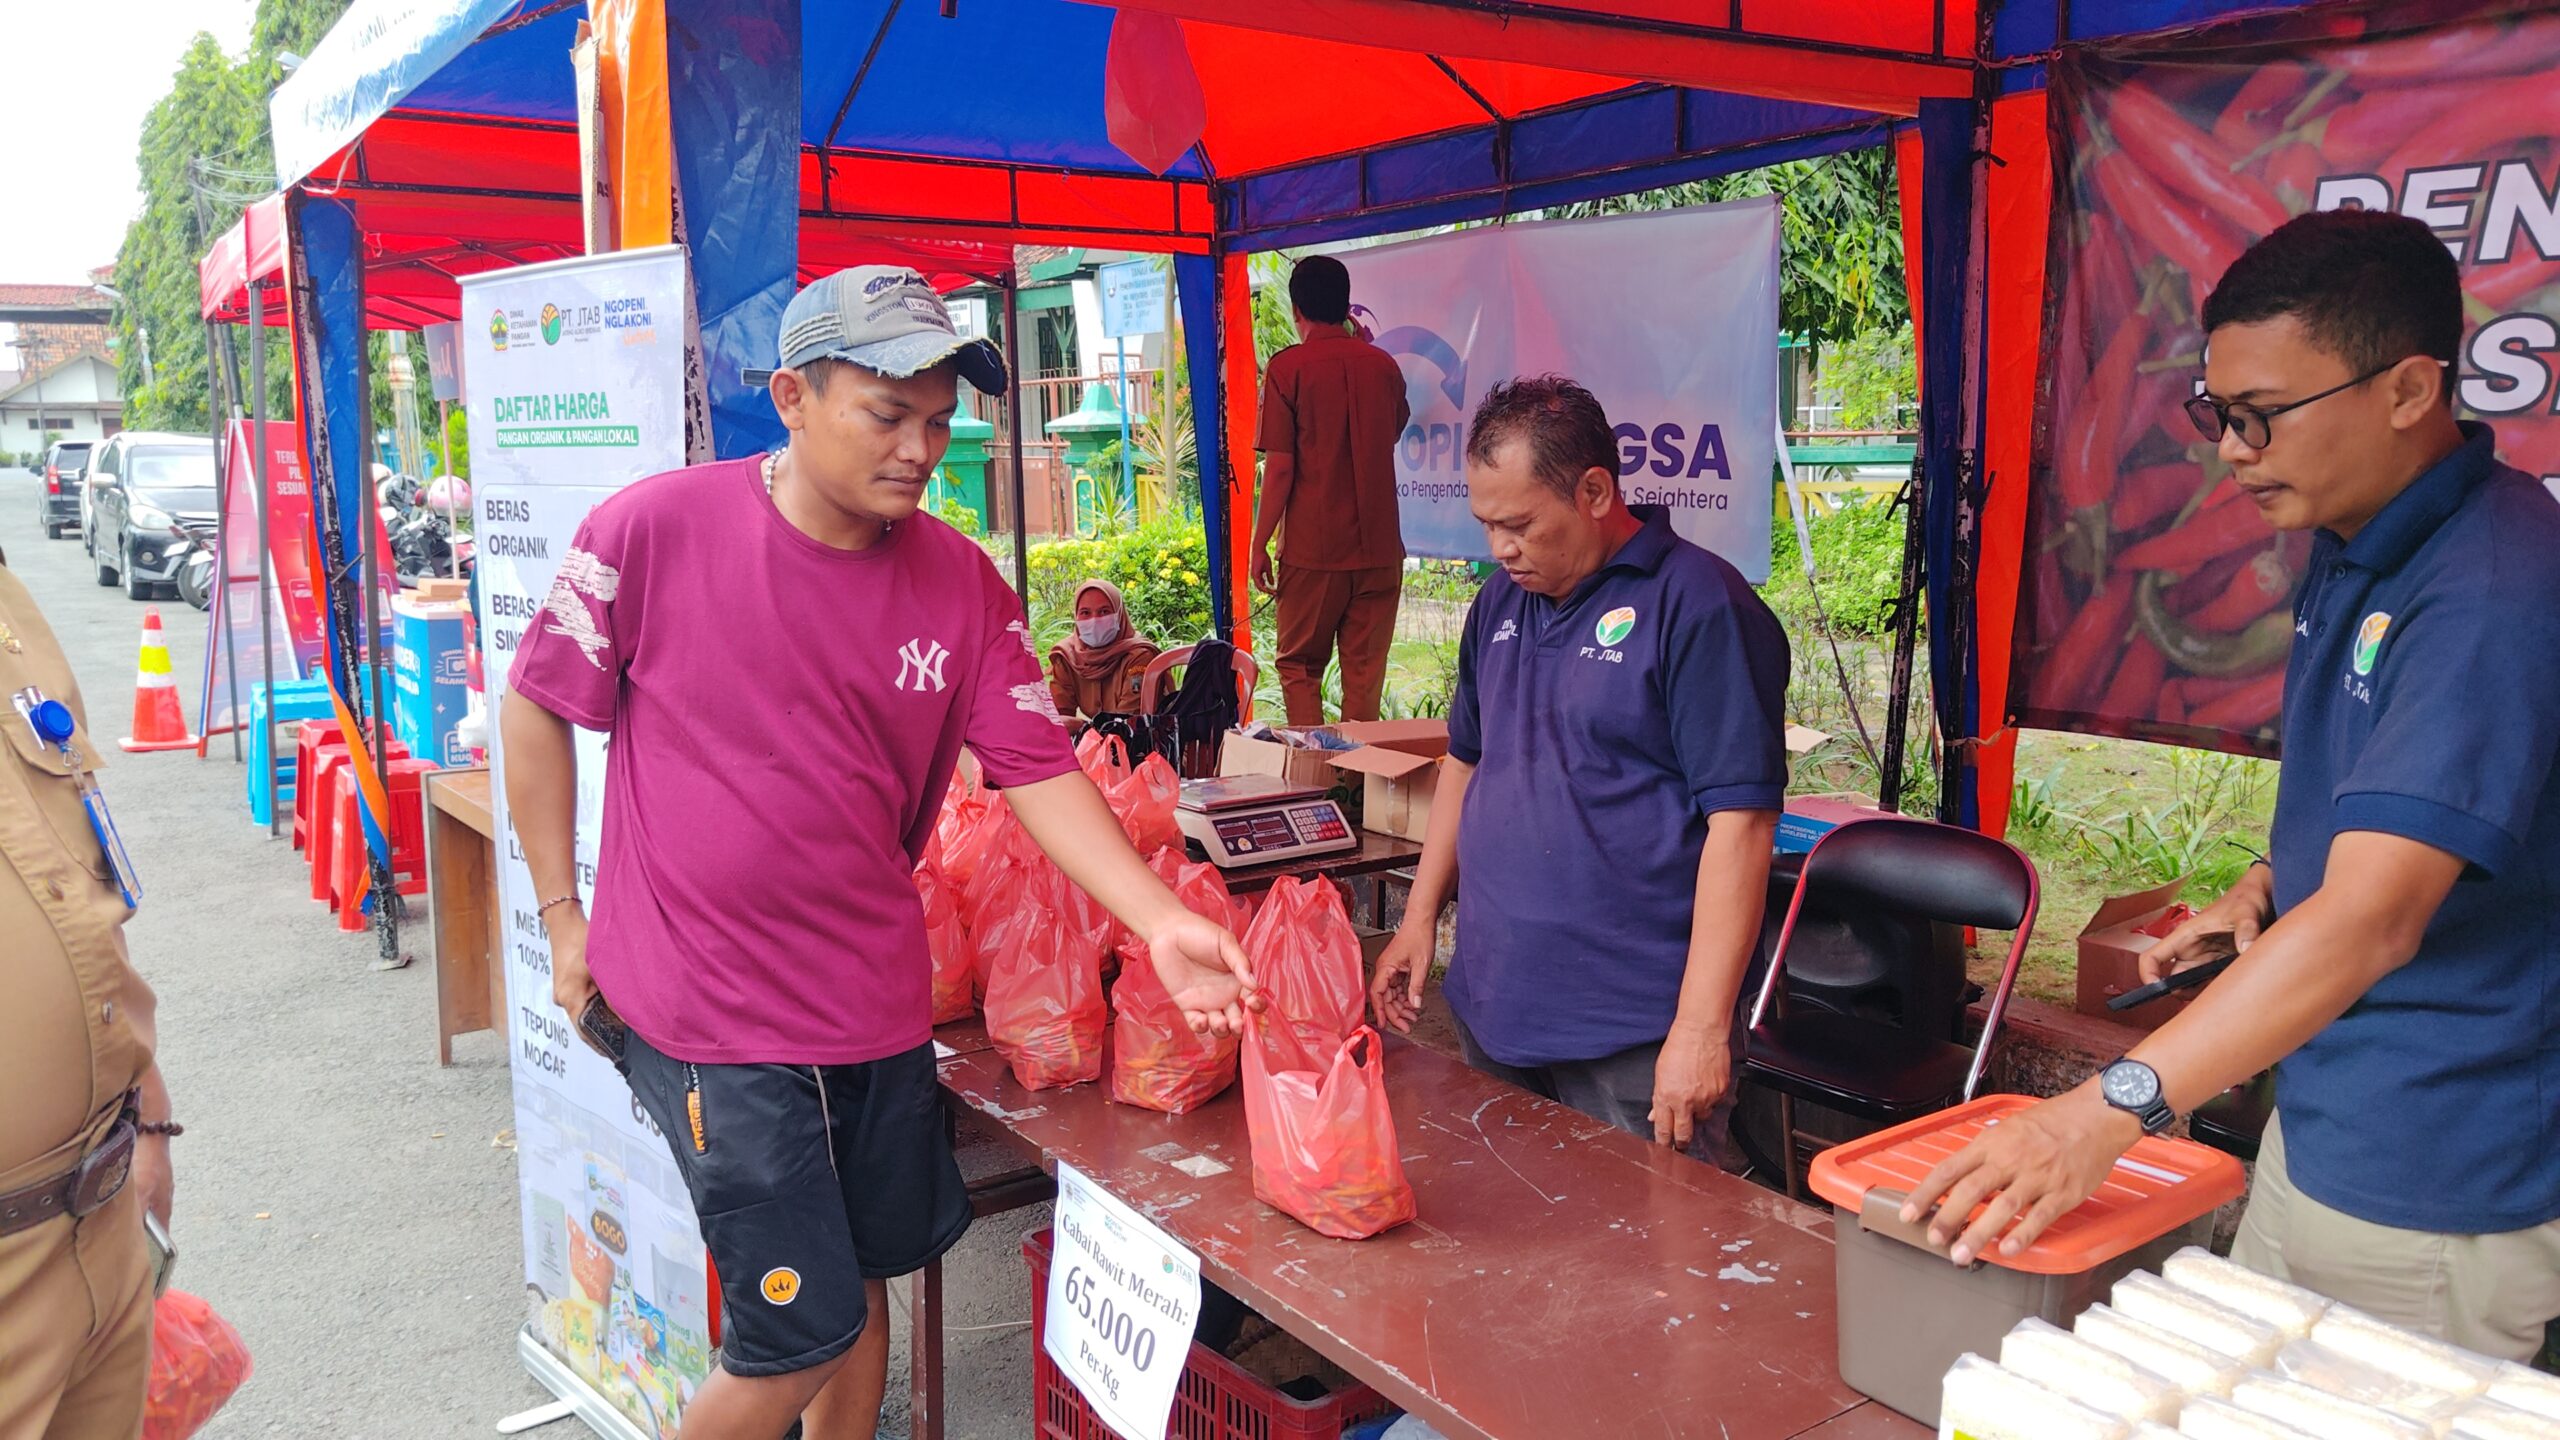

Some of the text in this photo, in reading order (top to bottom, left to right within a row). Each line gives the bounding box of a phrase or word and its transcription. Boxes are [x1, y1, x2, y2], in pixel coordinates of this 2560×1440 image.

[577, 305, 601, 328] JTAB
[604, 313, 652, 329] NGLAKONI
[864, 299, 905, 324] KINGSTON
[494, 391, 610, 423] DAFTAR HARGA
[498, 428, 637, 446] PANGAN ORGANIK & PANGAN LOKAL
[486, 499, 530, 523] BERAS
[488, 534, 549, 560] ORGANIK
[492, 593, 536, 620] BERAS
[894, 637, 950, 694] NY
[1579, 647, 1624, 664] PT. JTAB
[1779, 828, 1807, 840] WIRELESS
[515, 909, 536, 937] MIE
[517, 943, 550, 976] 100%
[522, 1006, 569, 1050] TEPUNG
[524, 1038, 567, 1080] MOCAF
[594, 1215, 625, 1249] BOGO
[1062, 1213, 1190, 1327] Cabai Rawit Merah:
[1065, 1265, 1156, 1373] 65.000
[1080, 1338, 1120, 1402] Per-Kg
